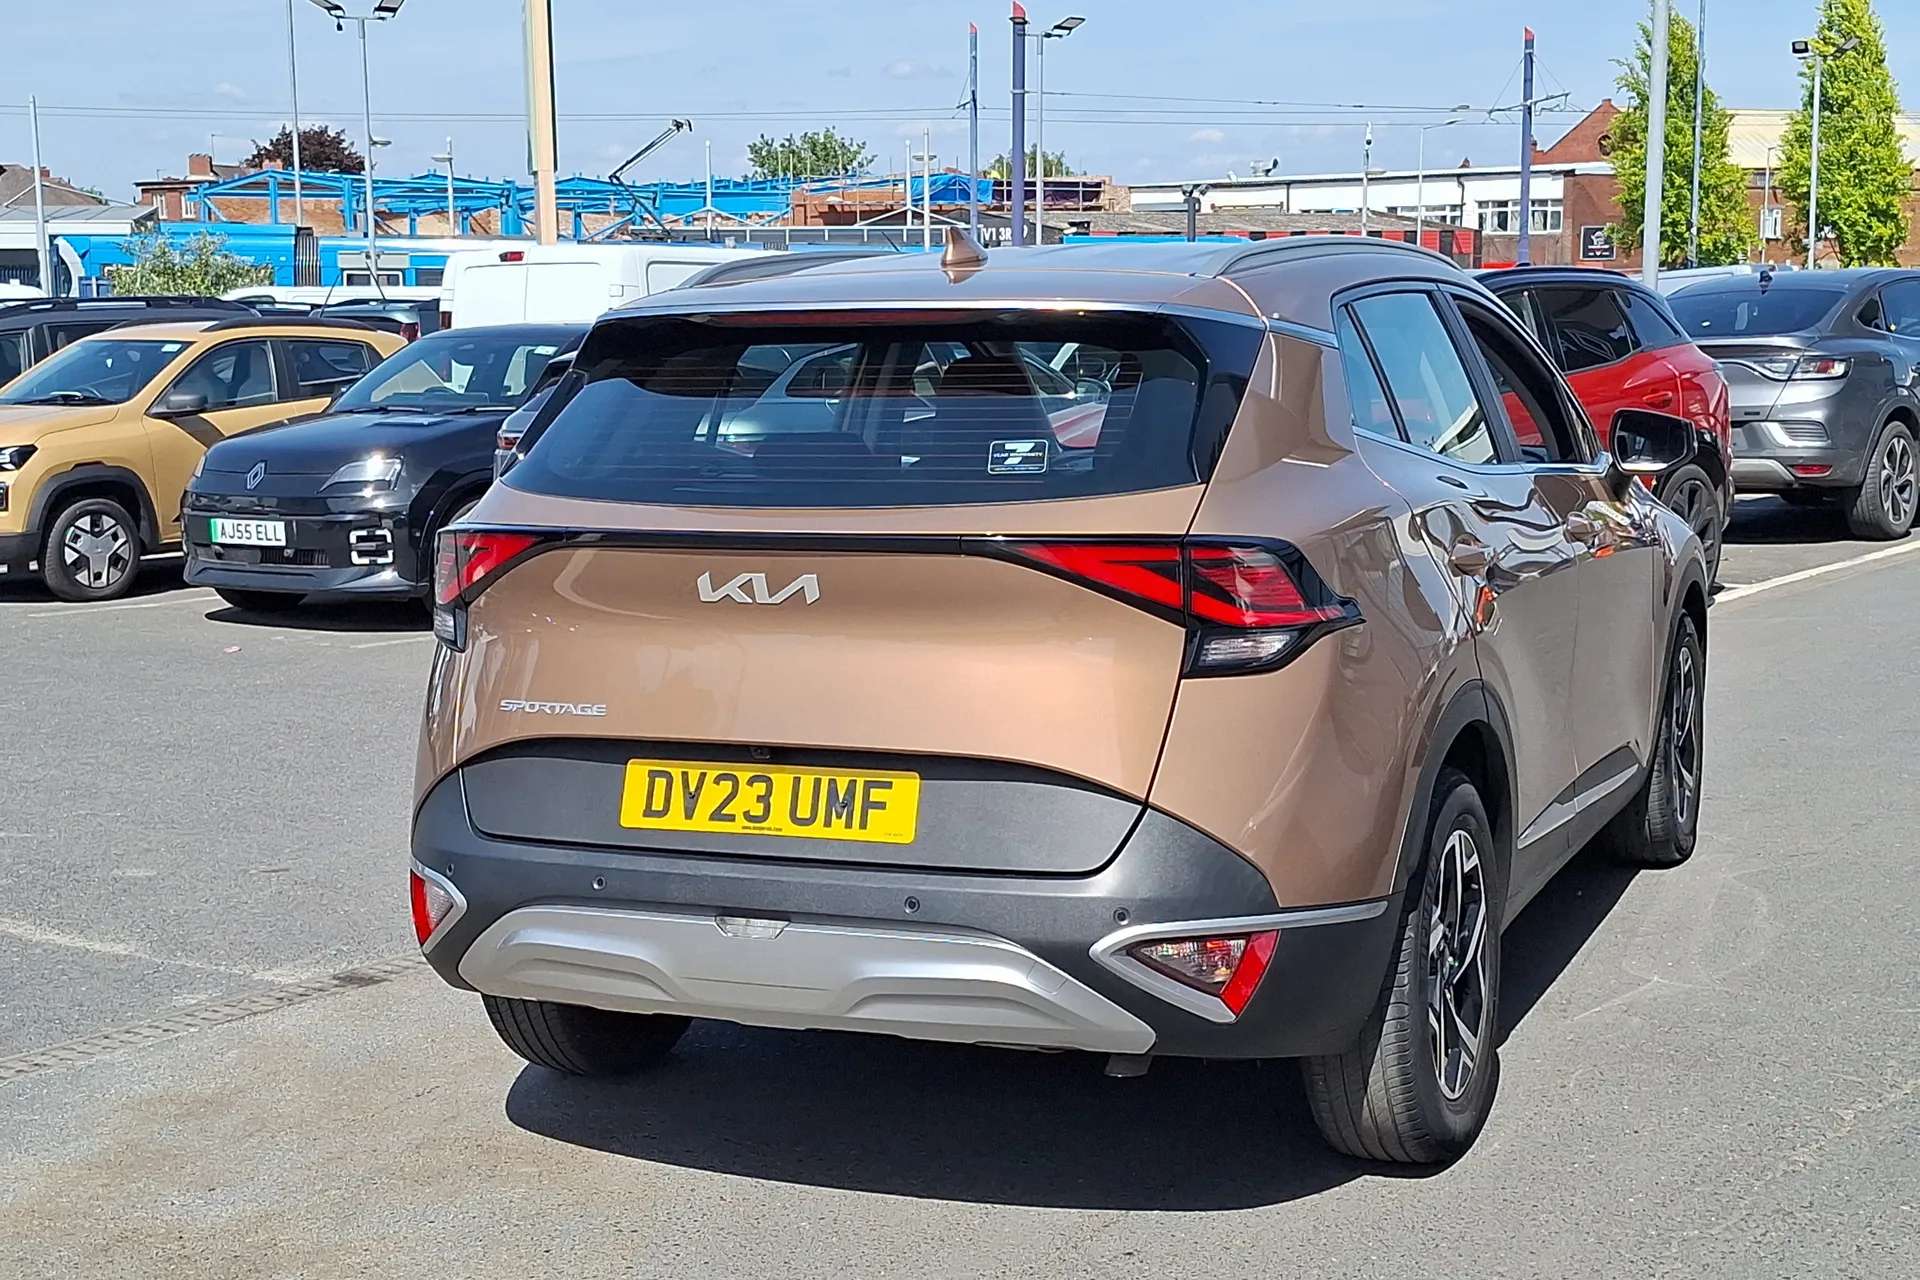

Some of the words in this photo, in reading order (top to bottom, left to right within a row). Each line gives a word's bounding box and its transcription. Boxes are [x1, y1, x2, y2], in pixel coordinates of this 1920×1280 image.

[220, 521, 252, 540] AJ55
[255, 524, 282, 542] ELL
[696, 570, 820, 605] KIA
[499, 699, 608, 716] SPORTAGE
[642, 769, 774, 824] DV23
[788, 776, 893, 831] UMF
